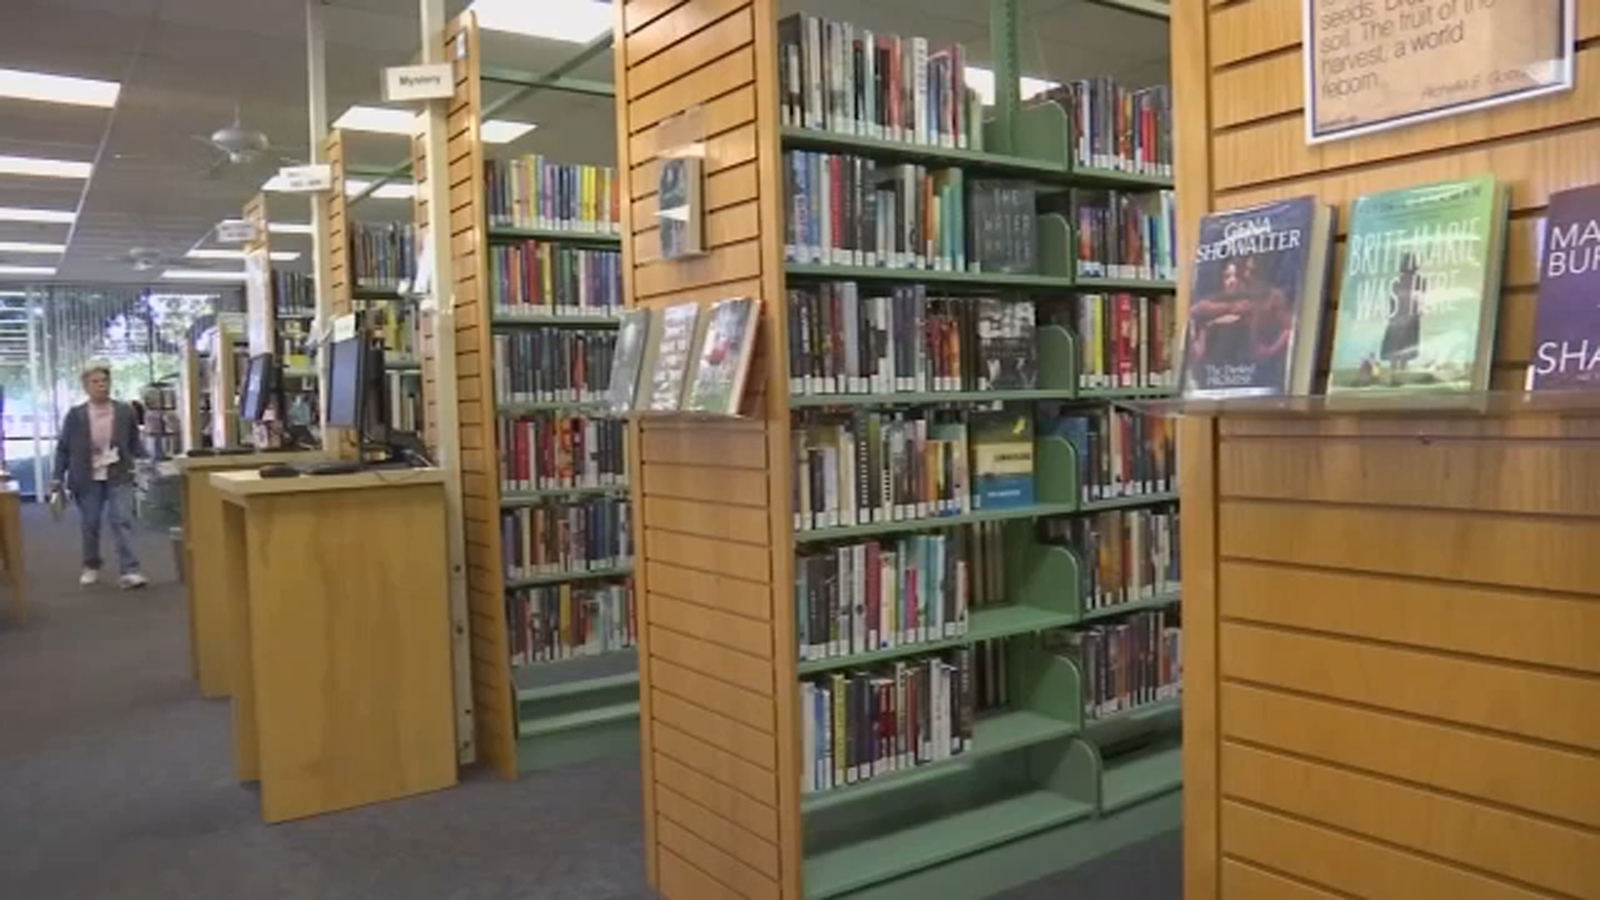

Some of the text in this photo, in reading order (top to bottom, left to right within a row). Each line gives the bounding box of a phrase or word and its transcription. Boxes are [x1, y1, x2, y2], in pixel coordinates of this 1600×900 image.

[1360, 19, 1394, 41] The
[1399, 5, 1433, 31] fruit
[1438, 0, 1461, 21] of
[1394, 40, 1406, 58] a
[1409, 19, 1464, 50] world
[399, 75, 441, 89] Mystery
[1195, 229, 1301, 264] SHOWALTER
[1223, 216, 1272, 241] GENA
[1356, 276, 1401, 322] WAS
